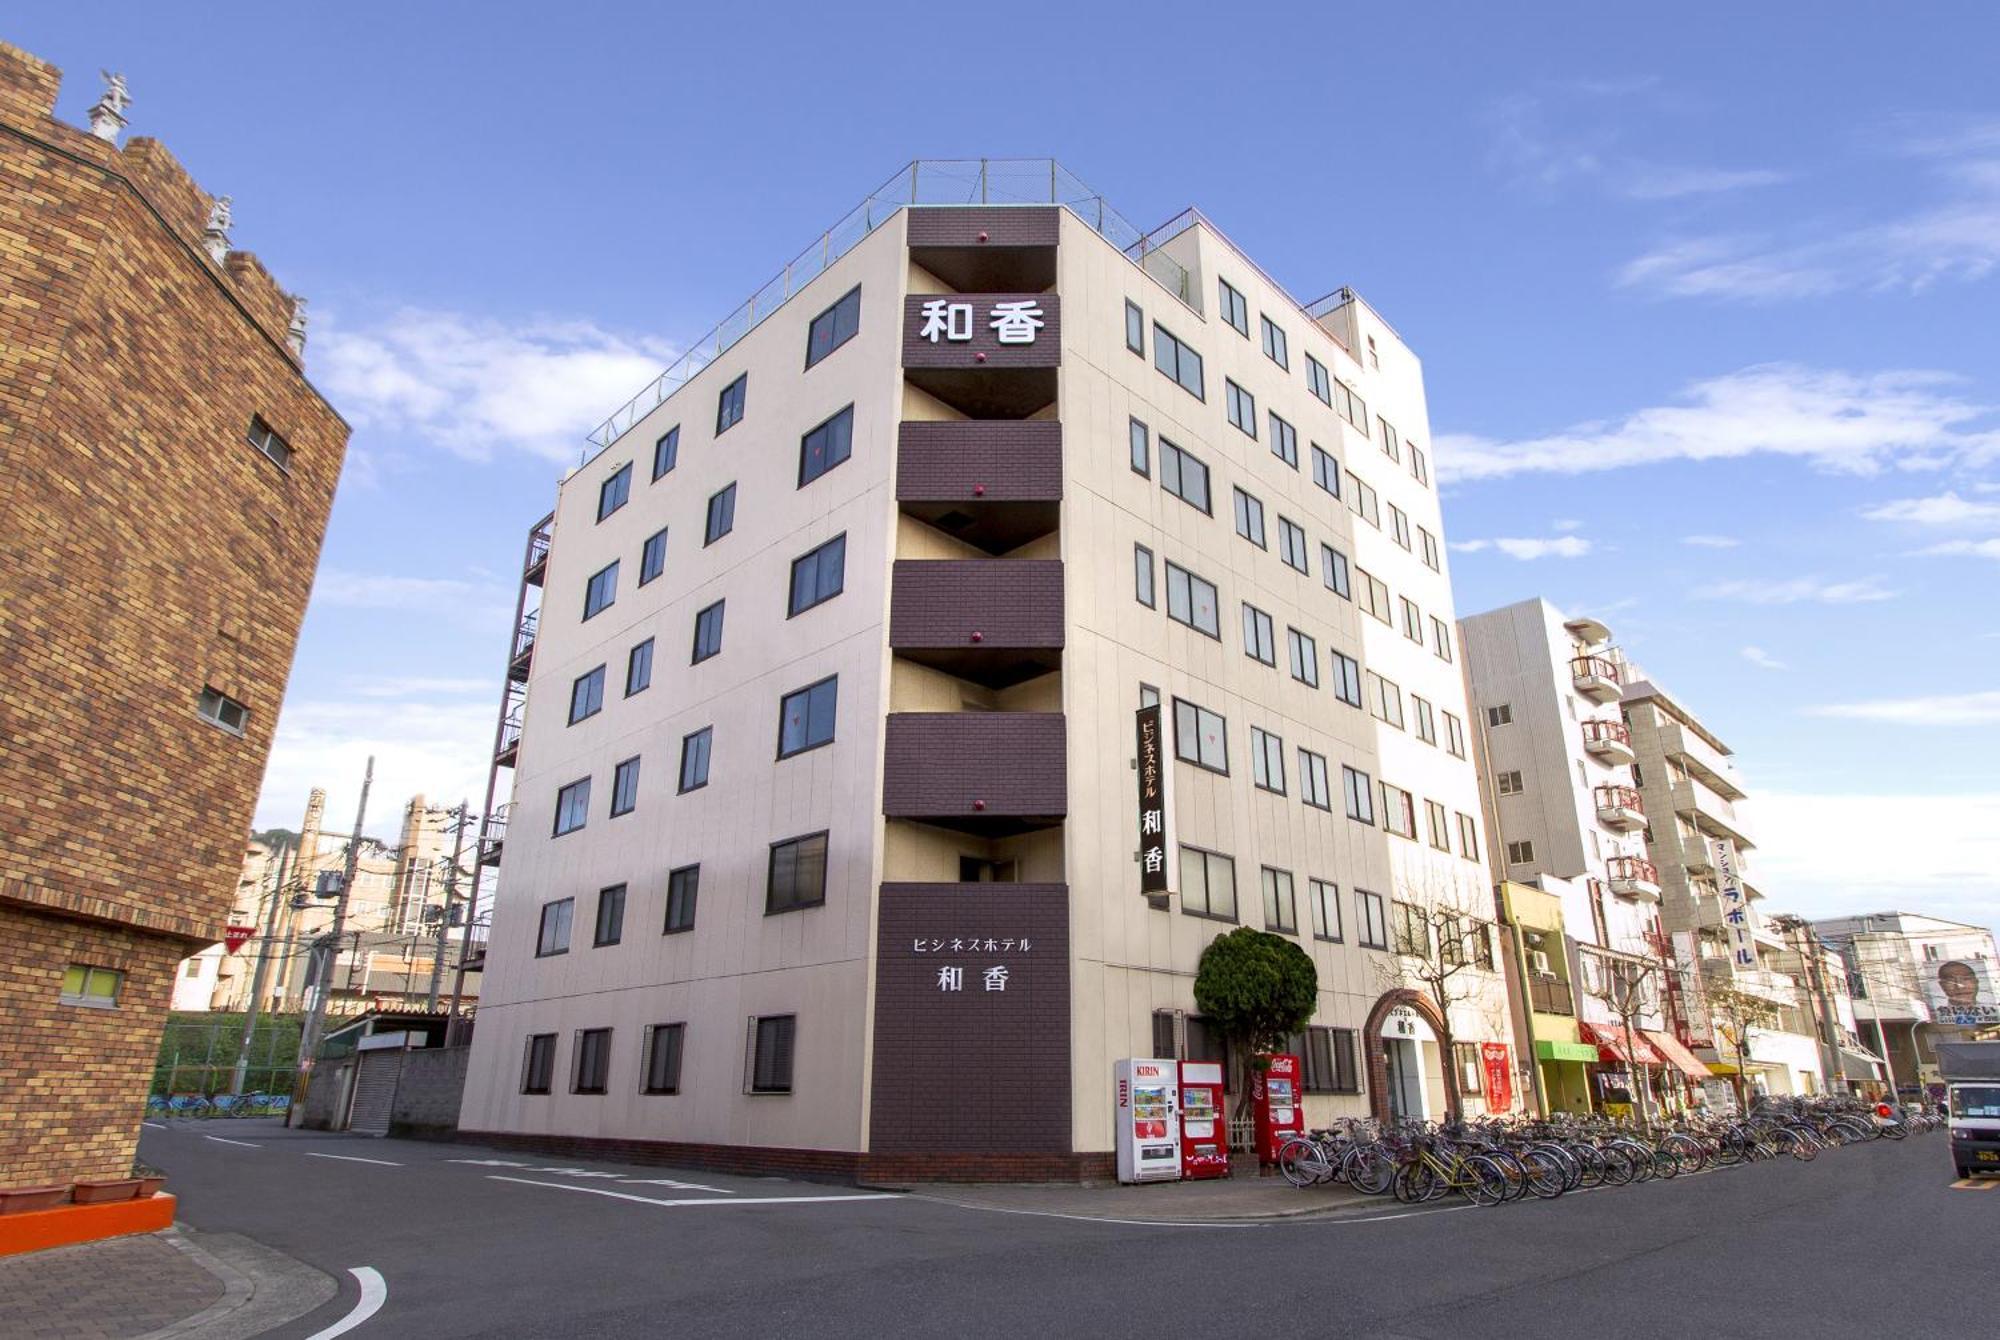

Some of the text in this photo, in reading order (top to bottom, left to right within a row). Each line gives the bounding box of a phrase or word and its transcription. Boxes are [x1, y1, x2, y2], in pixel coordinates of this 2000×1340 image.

[920, 299, 1044, 343] 和香
[1142, 810, 1163, 873] 和香
[937, 966, 1009, 991] 和香
[1136, 1066, 1159, 1077] KIRIN
